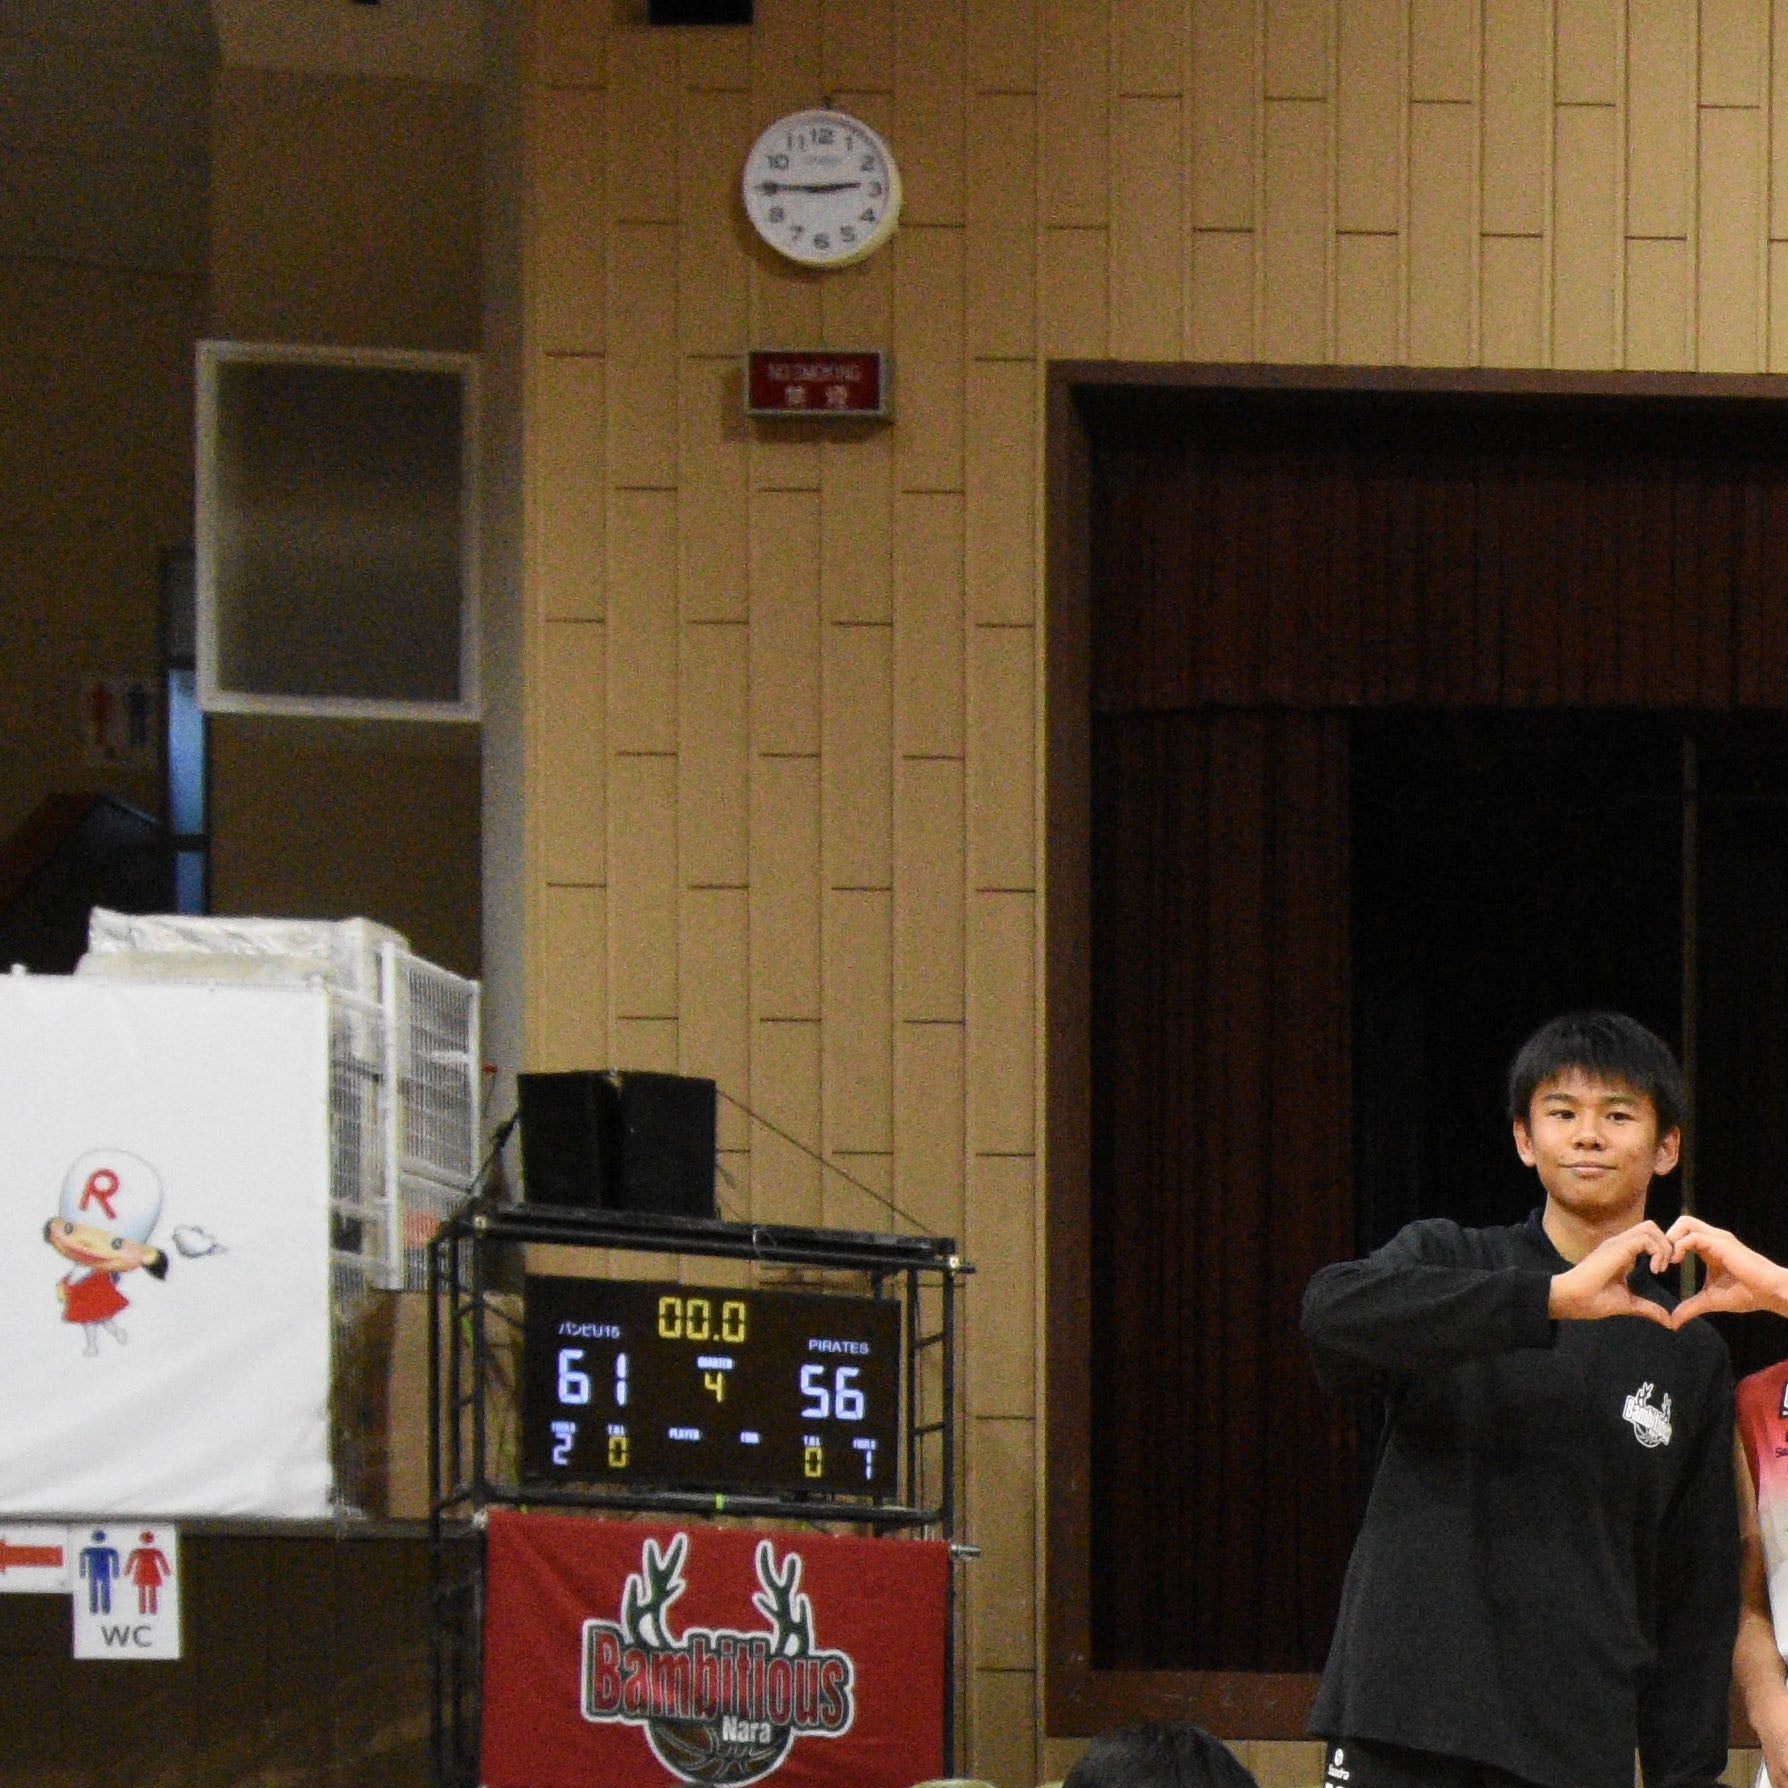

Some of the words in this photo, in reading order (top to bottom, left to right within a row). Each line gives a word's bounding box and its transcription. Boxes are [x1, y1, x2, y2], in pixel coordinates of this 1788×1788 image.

[787, 130, 804, 151] 11
[811, 127, 834, 144] 12
[767, 153, 789, 170] 10
[861, 155, 874, 171] 2
[869, 181, 882, 198] 3
[770, 206, 784, 223] 8
[861, 208, 875, 222] 4
[791, 225, 803, 240] 7
[814, 233, 829, 249] 6
[840, 226, 855, 242] 5
[659, 1296, 746, 1343] 00.0
[808, 1339, 869, 1355] PIRATES
[558, 1349, 627, 1406] 61
[704, 1372, 724, 1403] 4
[800, 1364, 864, 1421] 56
[551, 1434, 573, 1466] 2
[608, 1437, 628, 1468] 0
[805, 1447, 822, 1479] 0
[101, 1624, 151, 1650] WC
[588, 1625, 851, 1732] Bambitious
[722, 1714, 771, 1744] Nara
